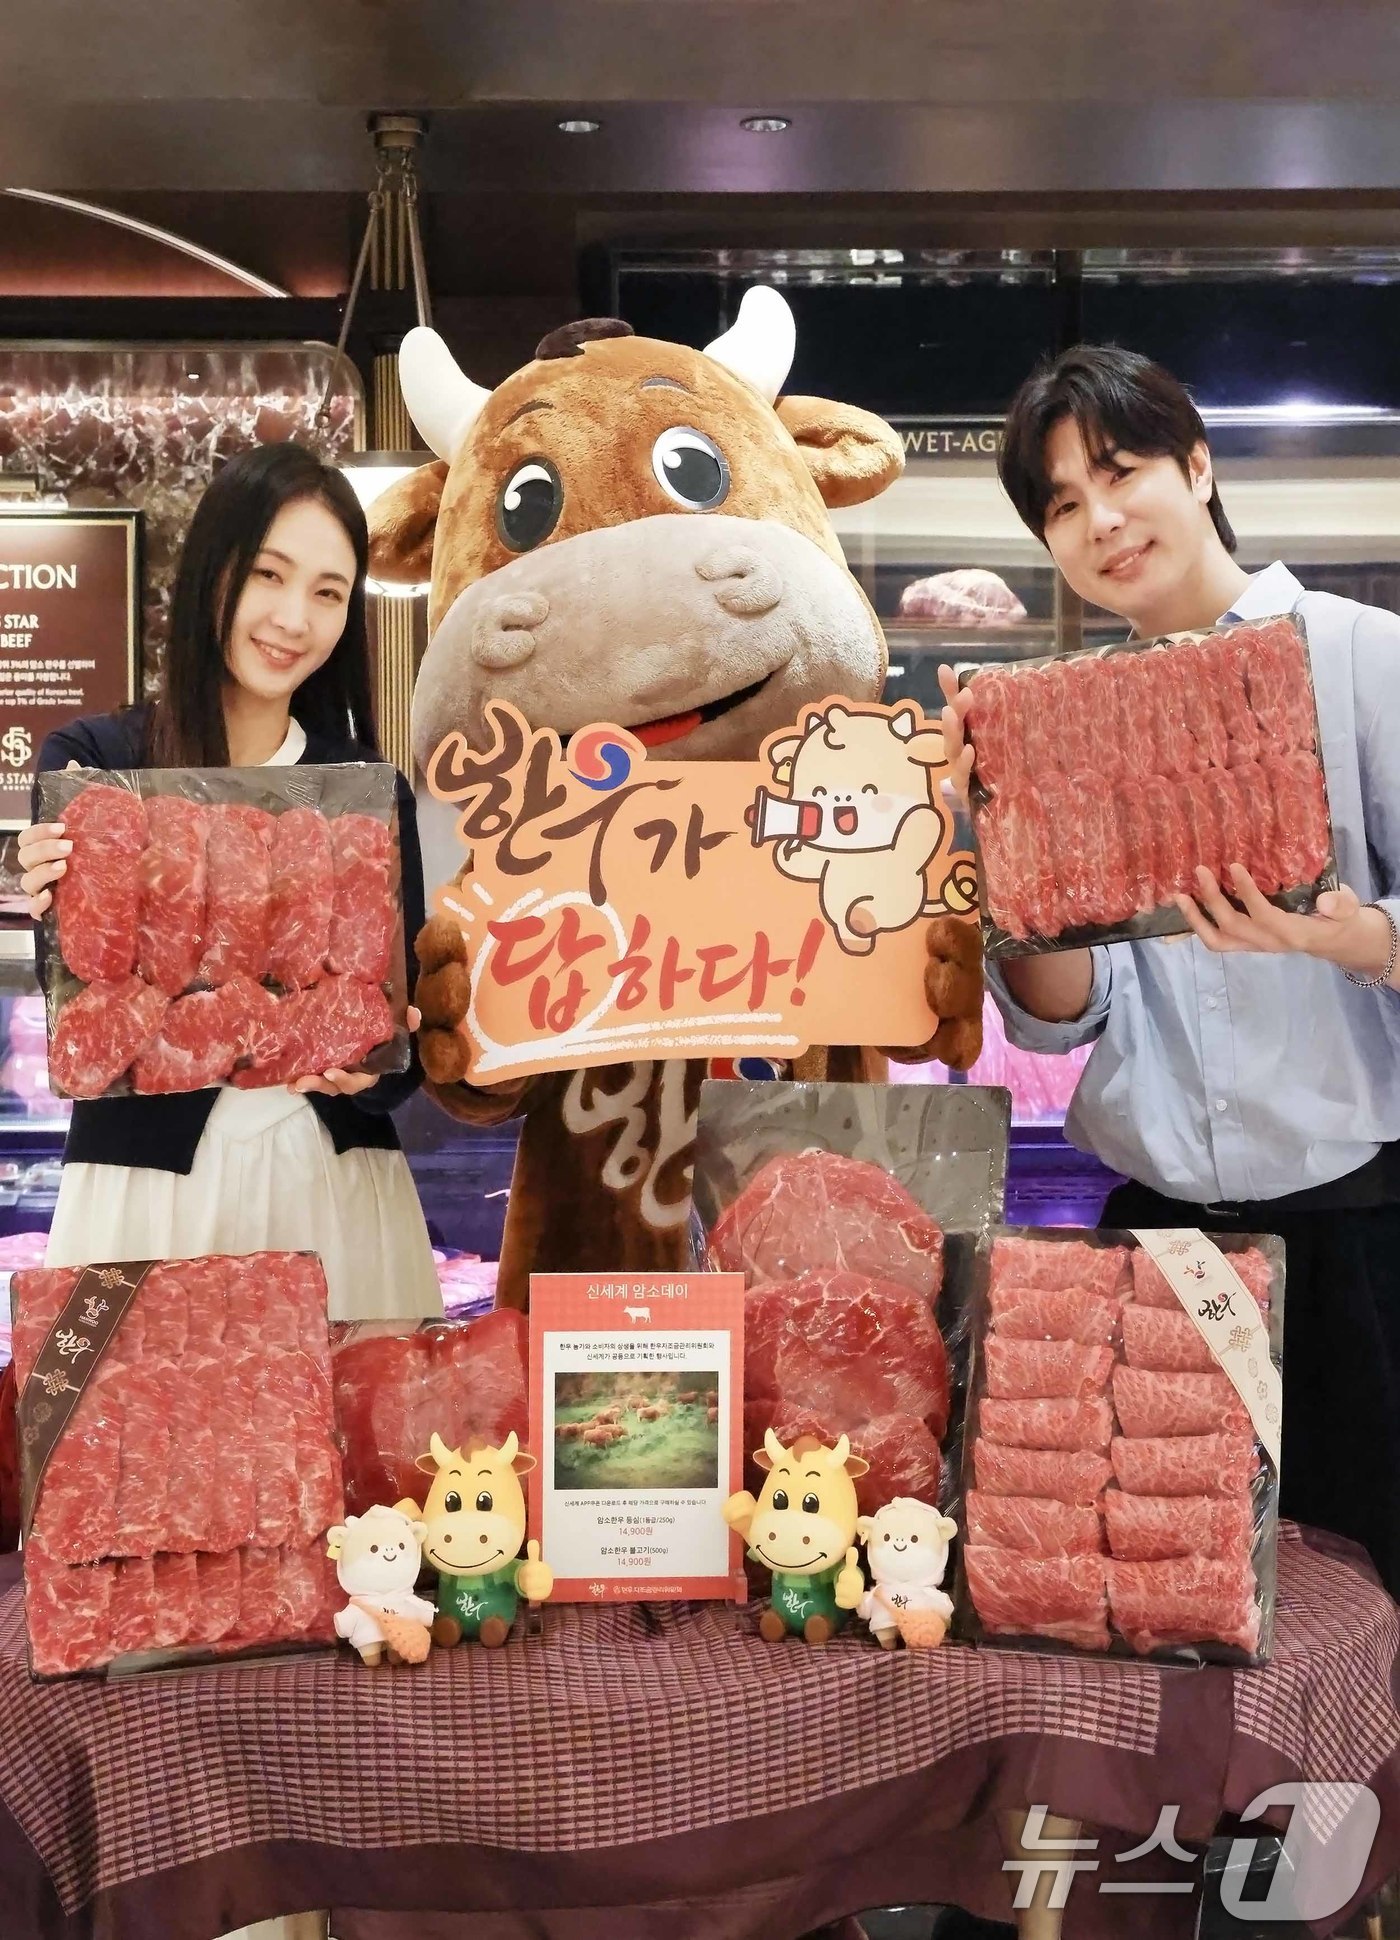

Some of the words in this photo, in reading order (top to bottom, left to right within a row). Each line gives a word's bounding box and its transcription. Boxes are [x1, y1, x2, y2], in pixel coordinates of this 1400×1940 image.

[4, 613, 39, 629] STAR
[1, 633, 33, 648] BEEF
[435, 706, 739, 907] 한우가
[487, 907, 826, 1033] 답하다!
[586, 1283, 628, 1299] 신세계
[632, 1283, 688, 1299] 암소데이
[1198, 1292, 1237, 1322] 한우
[55, 1328, 95, 1364] 한우
[559, 1342, 572, 1350] 한우
[592, 1342, 616, 1350] 소비자의
[617, 1342, 635, 1350] 상생을
[636, 1342, 649, 1350] 위해
[597, 1516, 624, 1524] 암소한우
[619, 1527, 653, 1536] 14,900원
[600, 1546, 627, 1555] 암소한우
[629, 1546, 669, 1555] 불고기(500g)
[617, 1557, 651, 1567] 14,900원
[455, 1592, 489, 1621] 한우
[782, 1588, 814, 1618] 한우
